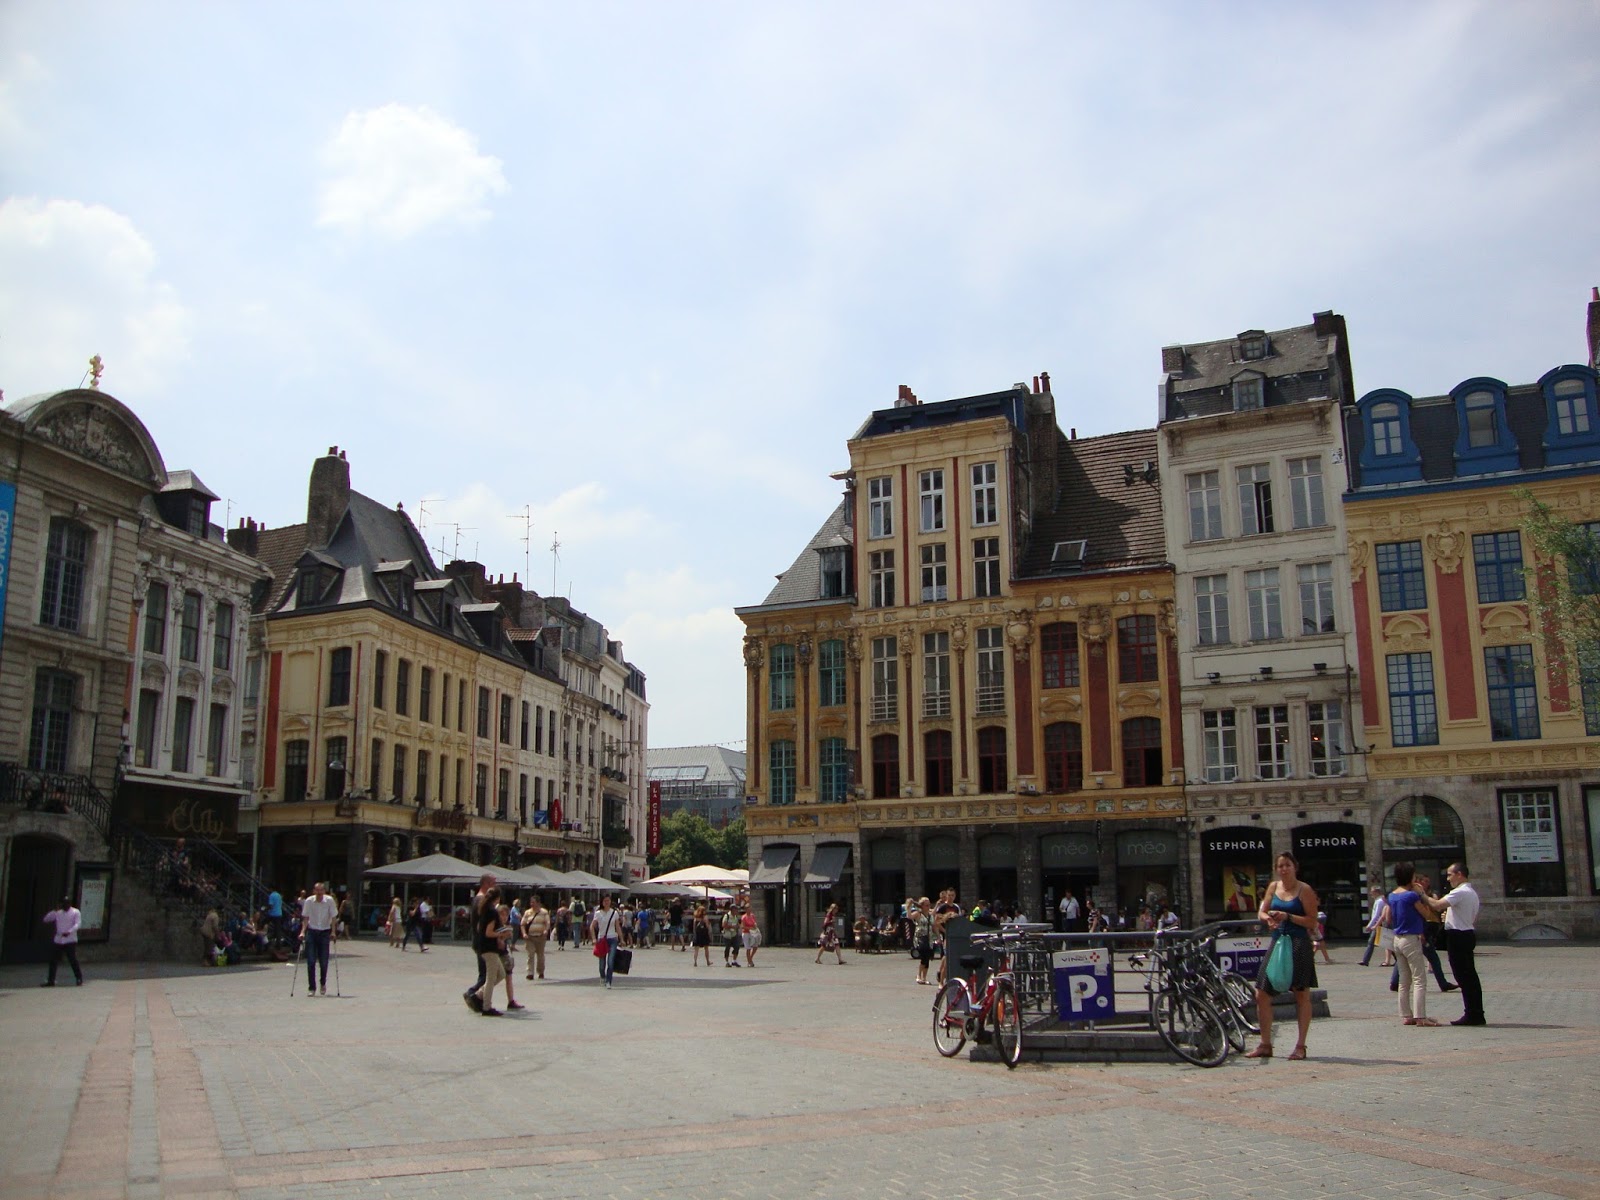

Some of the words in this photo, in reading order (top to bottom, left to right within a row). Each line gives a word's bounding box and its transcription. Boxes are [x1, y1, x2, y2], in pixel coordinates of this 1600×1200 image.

[652, 787, 658, 798] LA
[1209, 840, 1265, 851] SEPHORA
[1299, 836, 1357, 848] SEPHORA
[1220, 956, 1233, 973] P
[1238, 956, 1260, 964] GRAND
